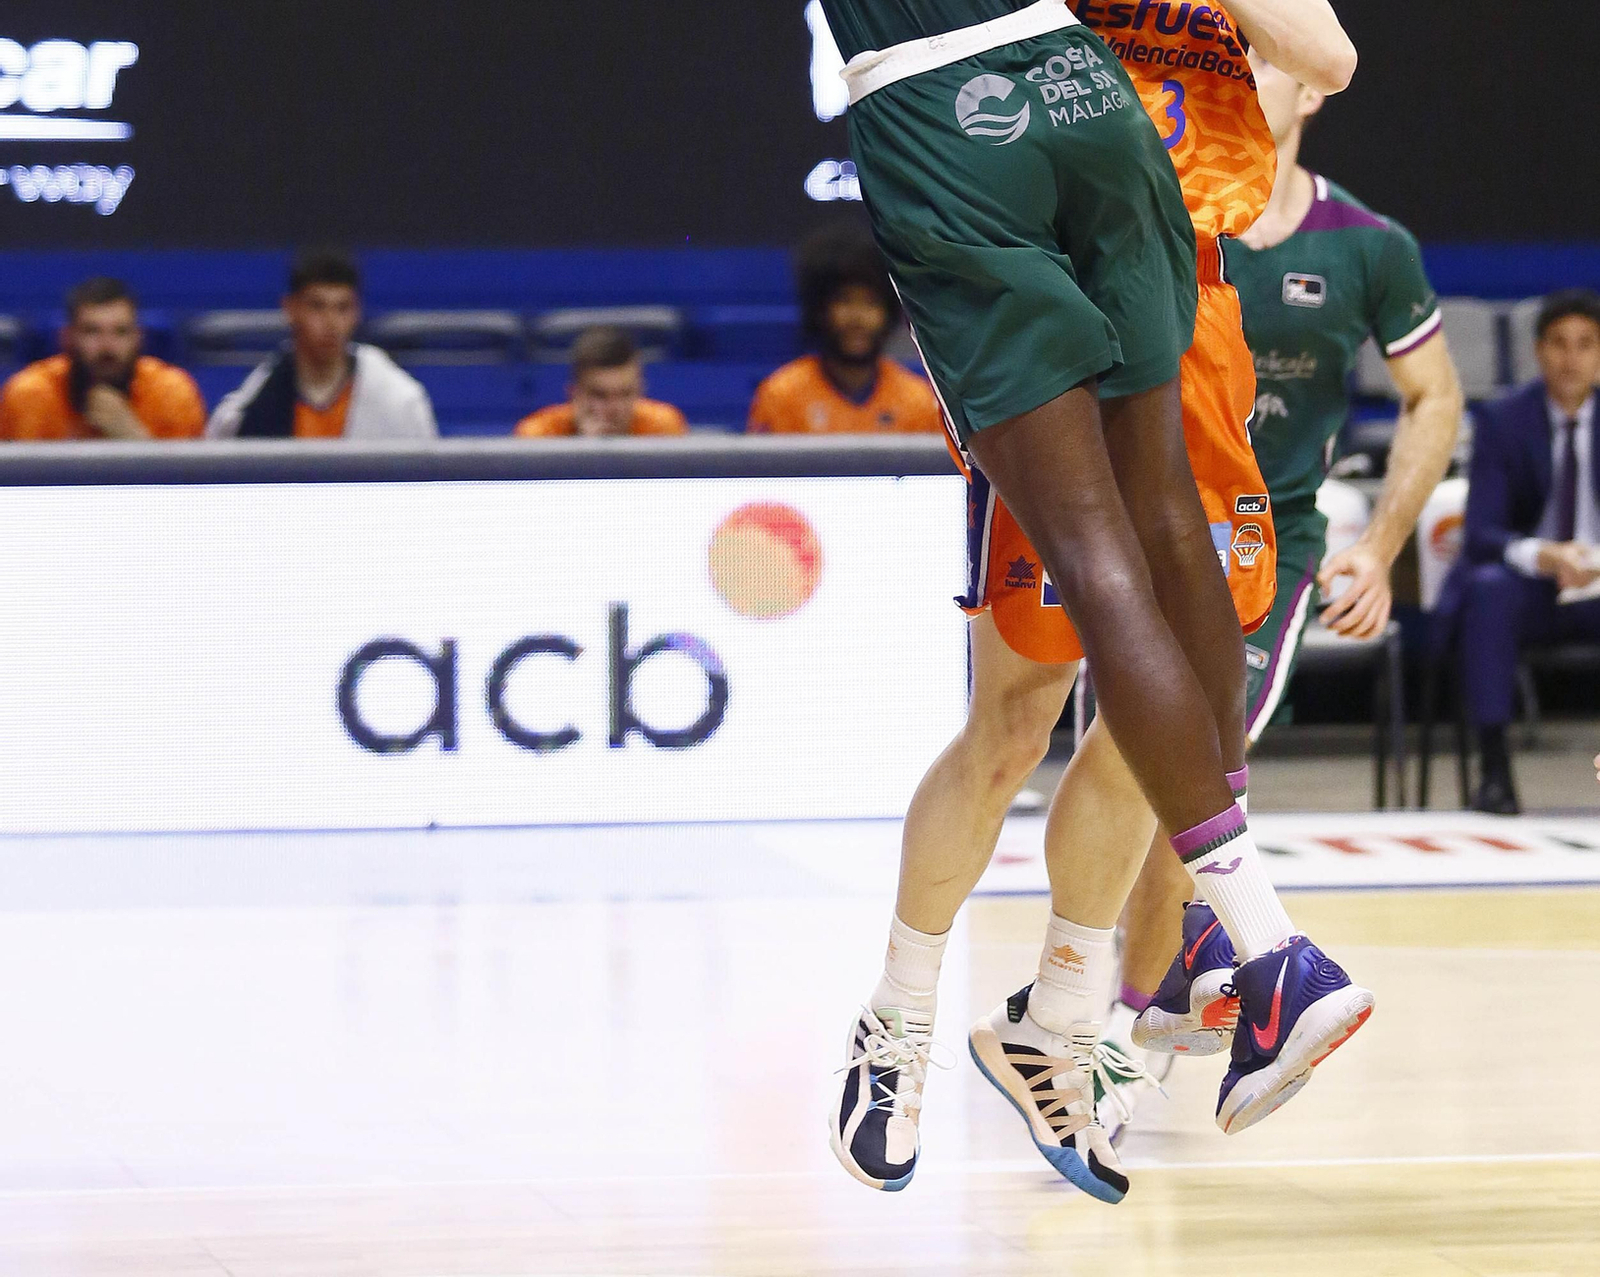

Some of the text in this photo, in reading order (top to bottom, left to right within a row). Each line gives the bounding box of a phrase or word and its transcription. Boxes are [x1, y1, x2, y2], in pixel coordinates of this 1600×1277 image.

[1039, 79, 1092, 105] DEL
[1238, 501, 1261, 512] acb
[336, 600, 731, 754] acb
